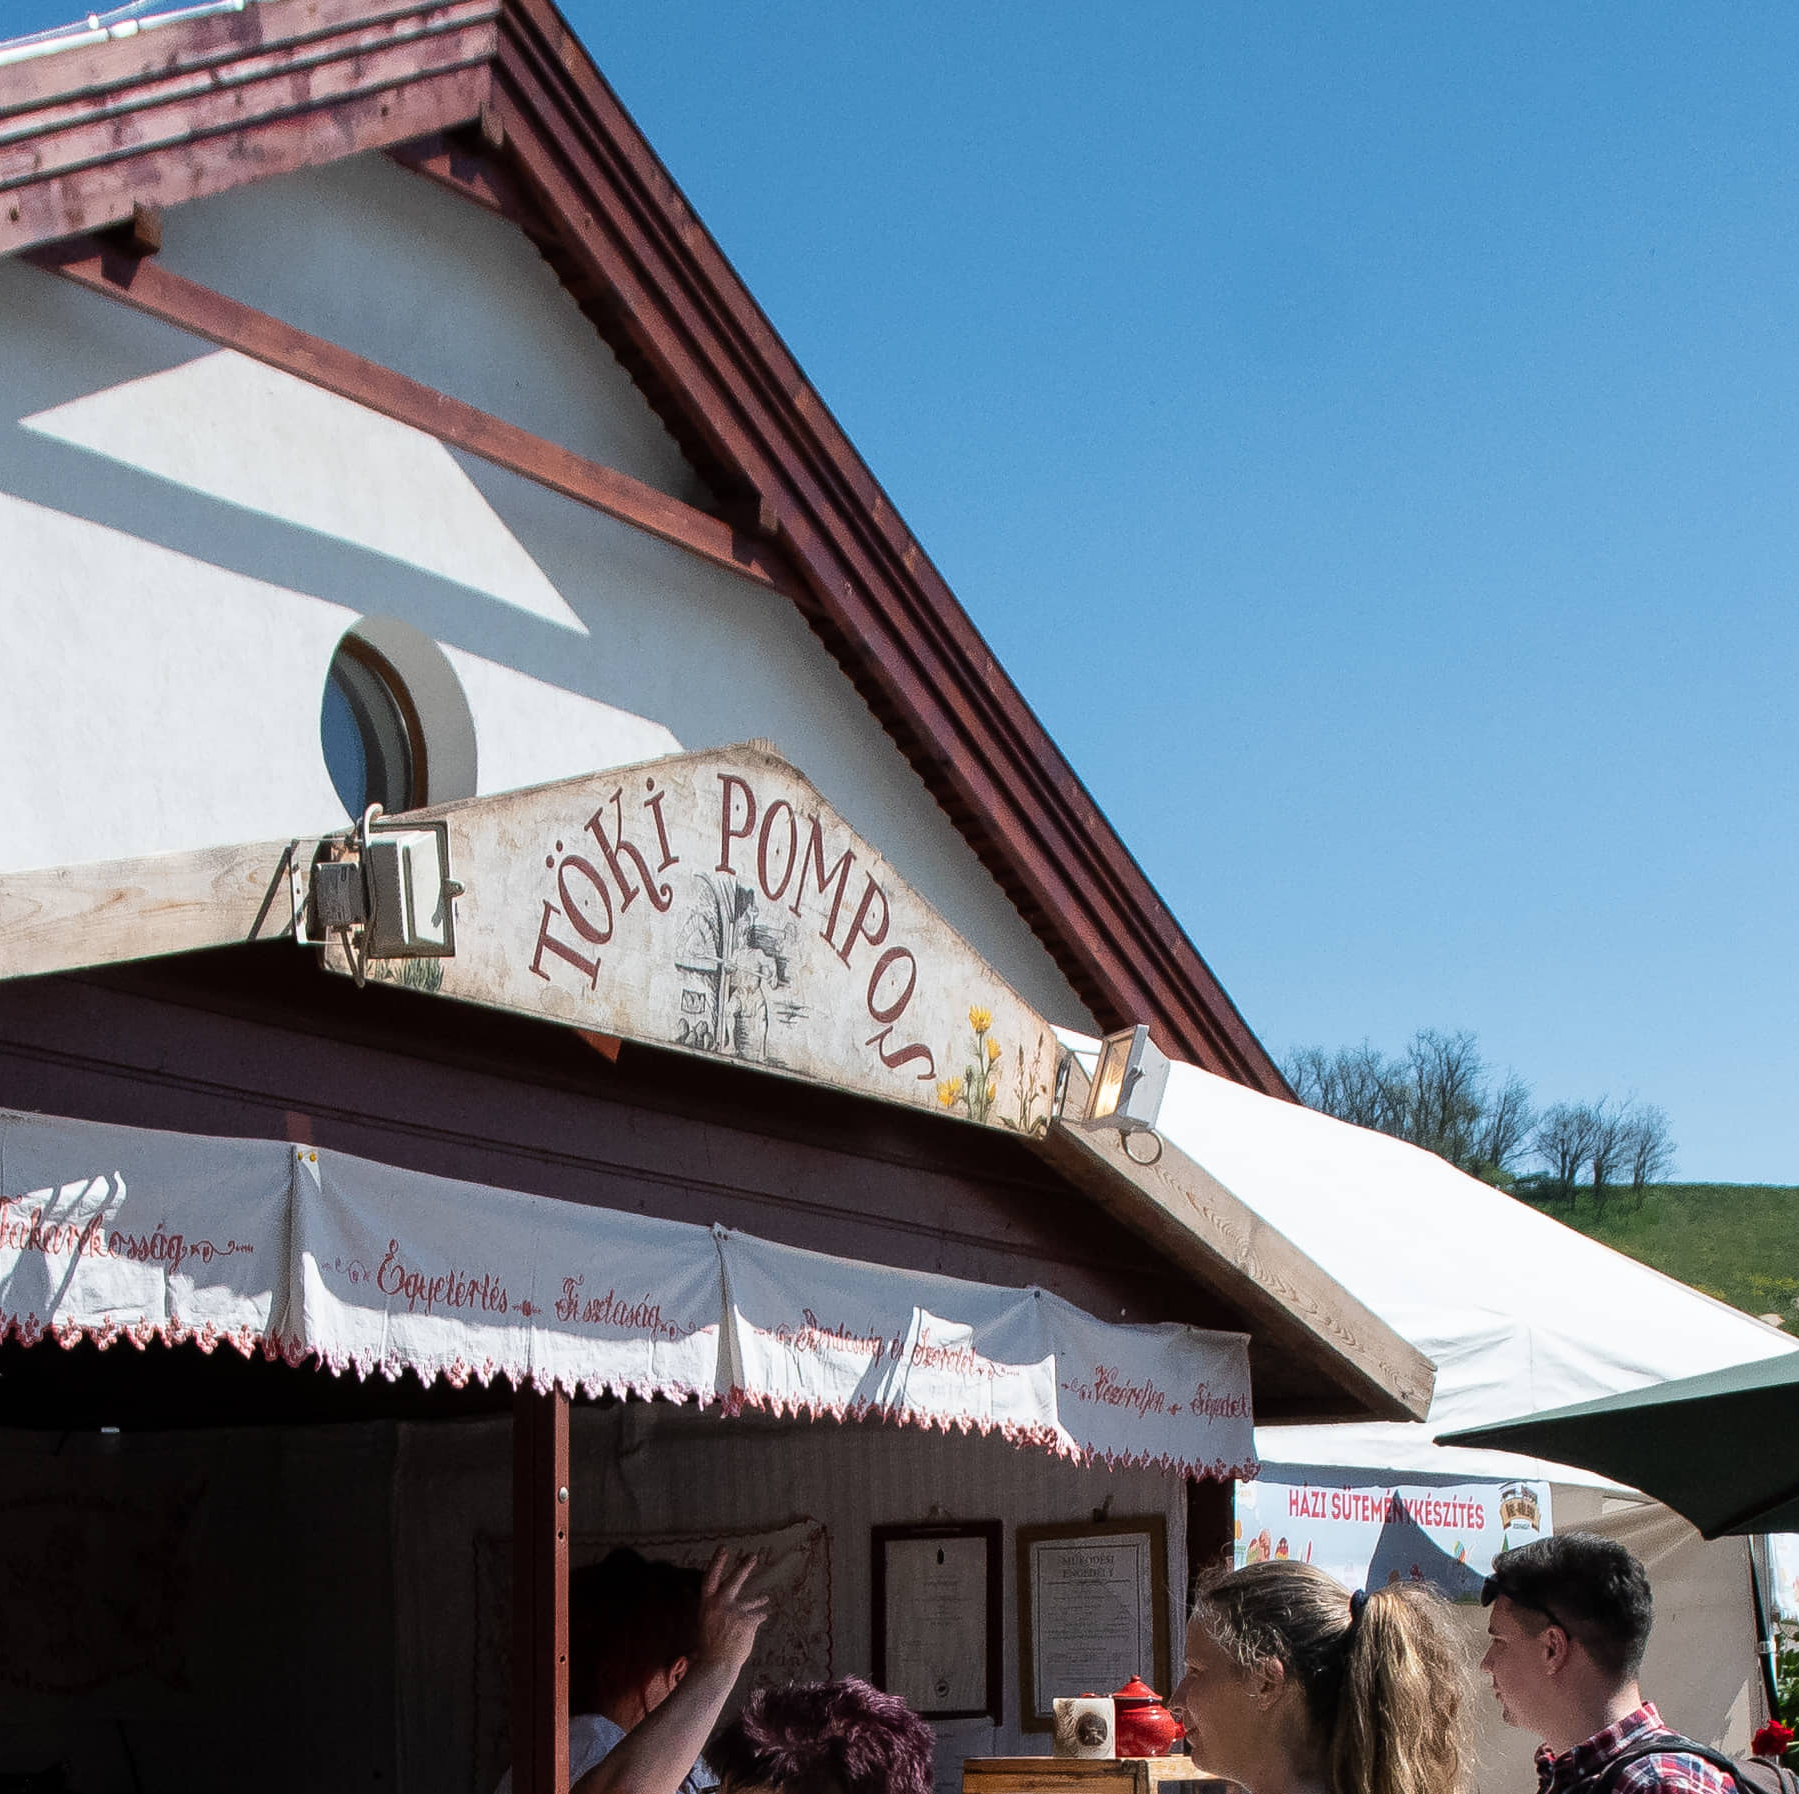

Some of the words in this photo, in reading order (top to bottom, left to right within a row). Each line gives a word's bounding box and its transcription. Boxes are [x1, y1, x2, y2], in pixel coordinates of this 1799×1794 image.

[715, 772, 937, 1082] POMPOS
[554, 1274, 663, 1341] Tisztaság
[1289, 1480, 1327, 1519] HÁZI
